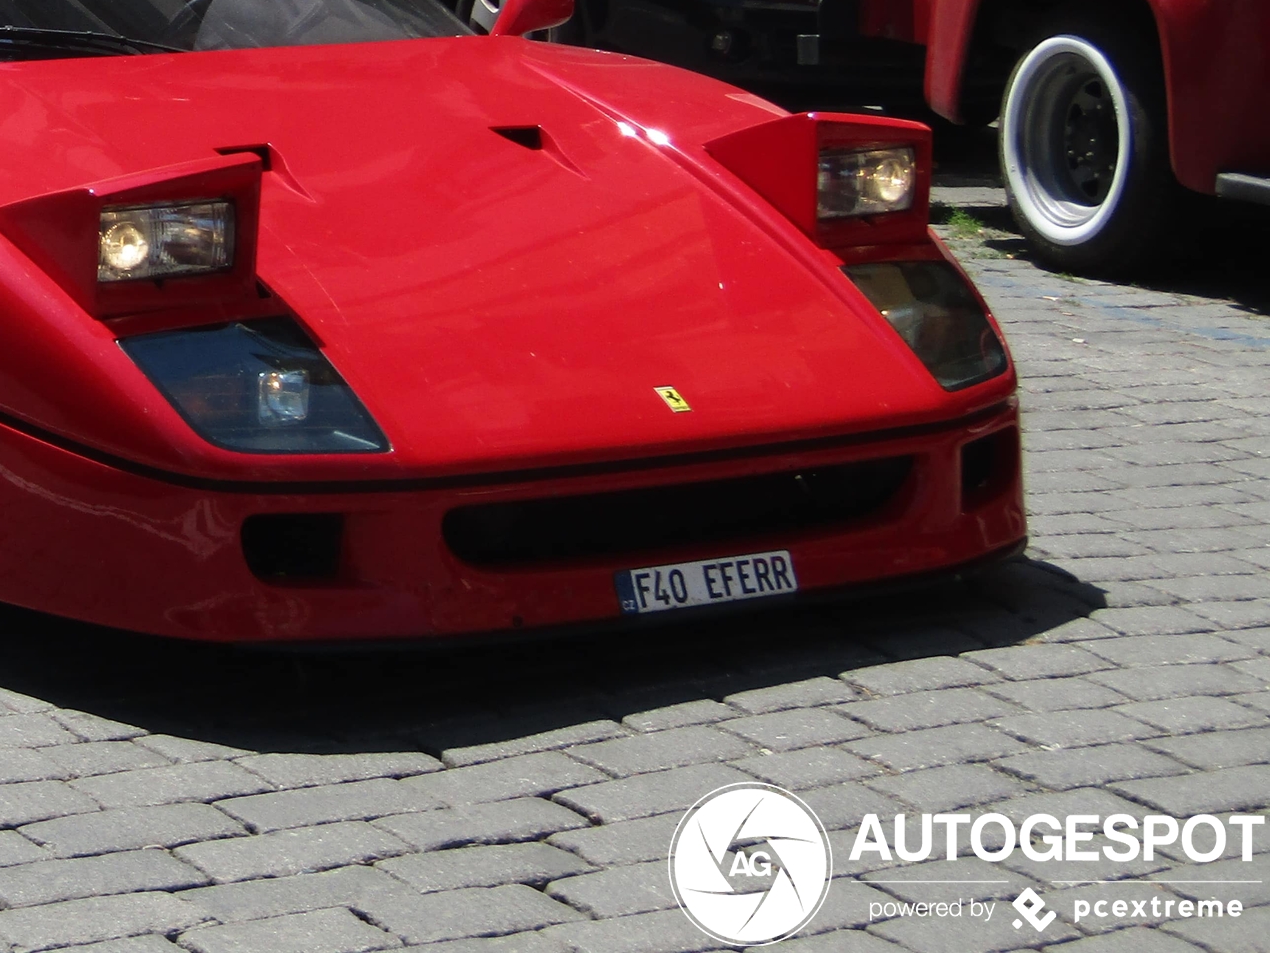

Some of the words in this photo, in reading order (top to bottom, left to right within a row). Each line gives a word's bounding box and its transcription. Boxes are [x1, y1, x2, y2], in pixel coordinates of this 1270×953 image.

[634, 568, 688, 609] F40
[702, 555, 793, 599] EFERR
[622, 599, 637, 611] CZ
